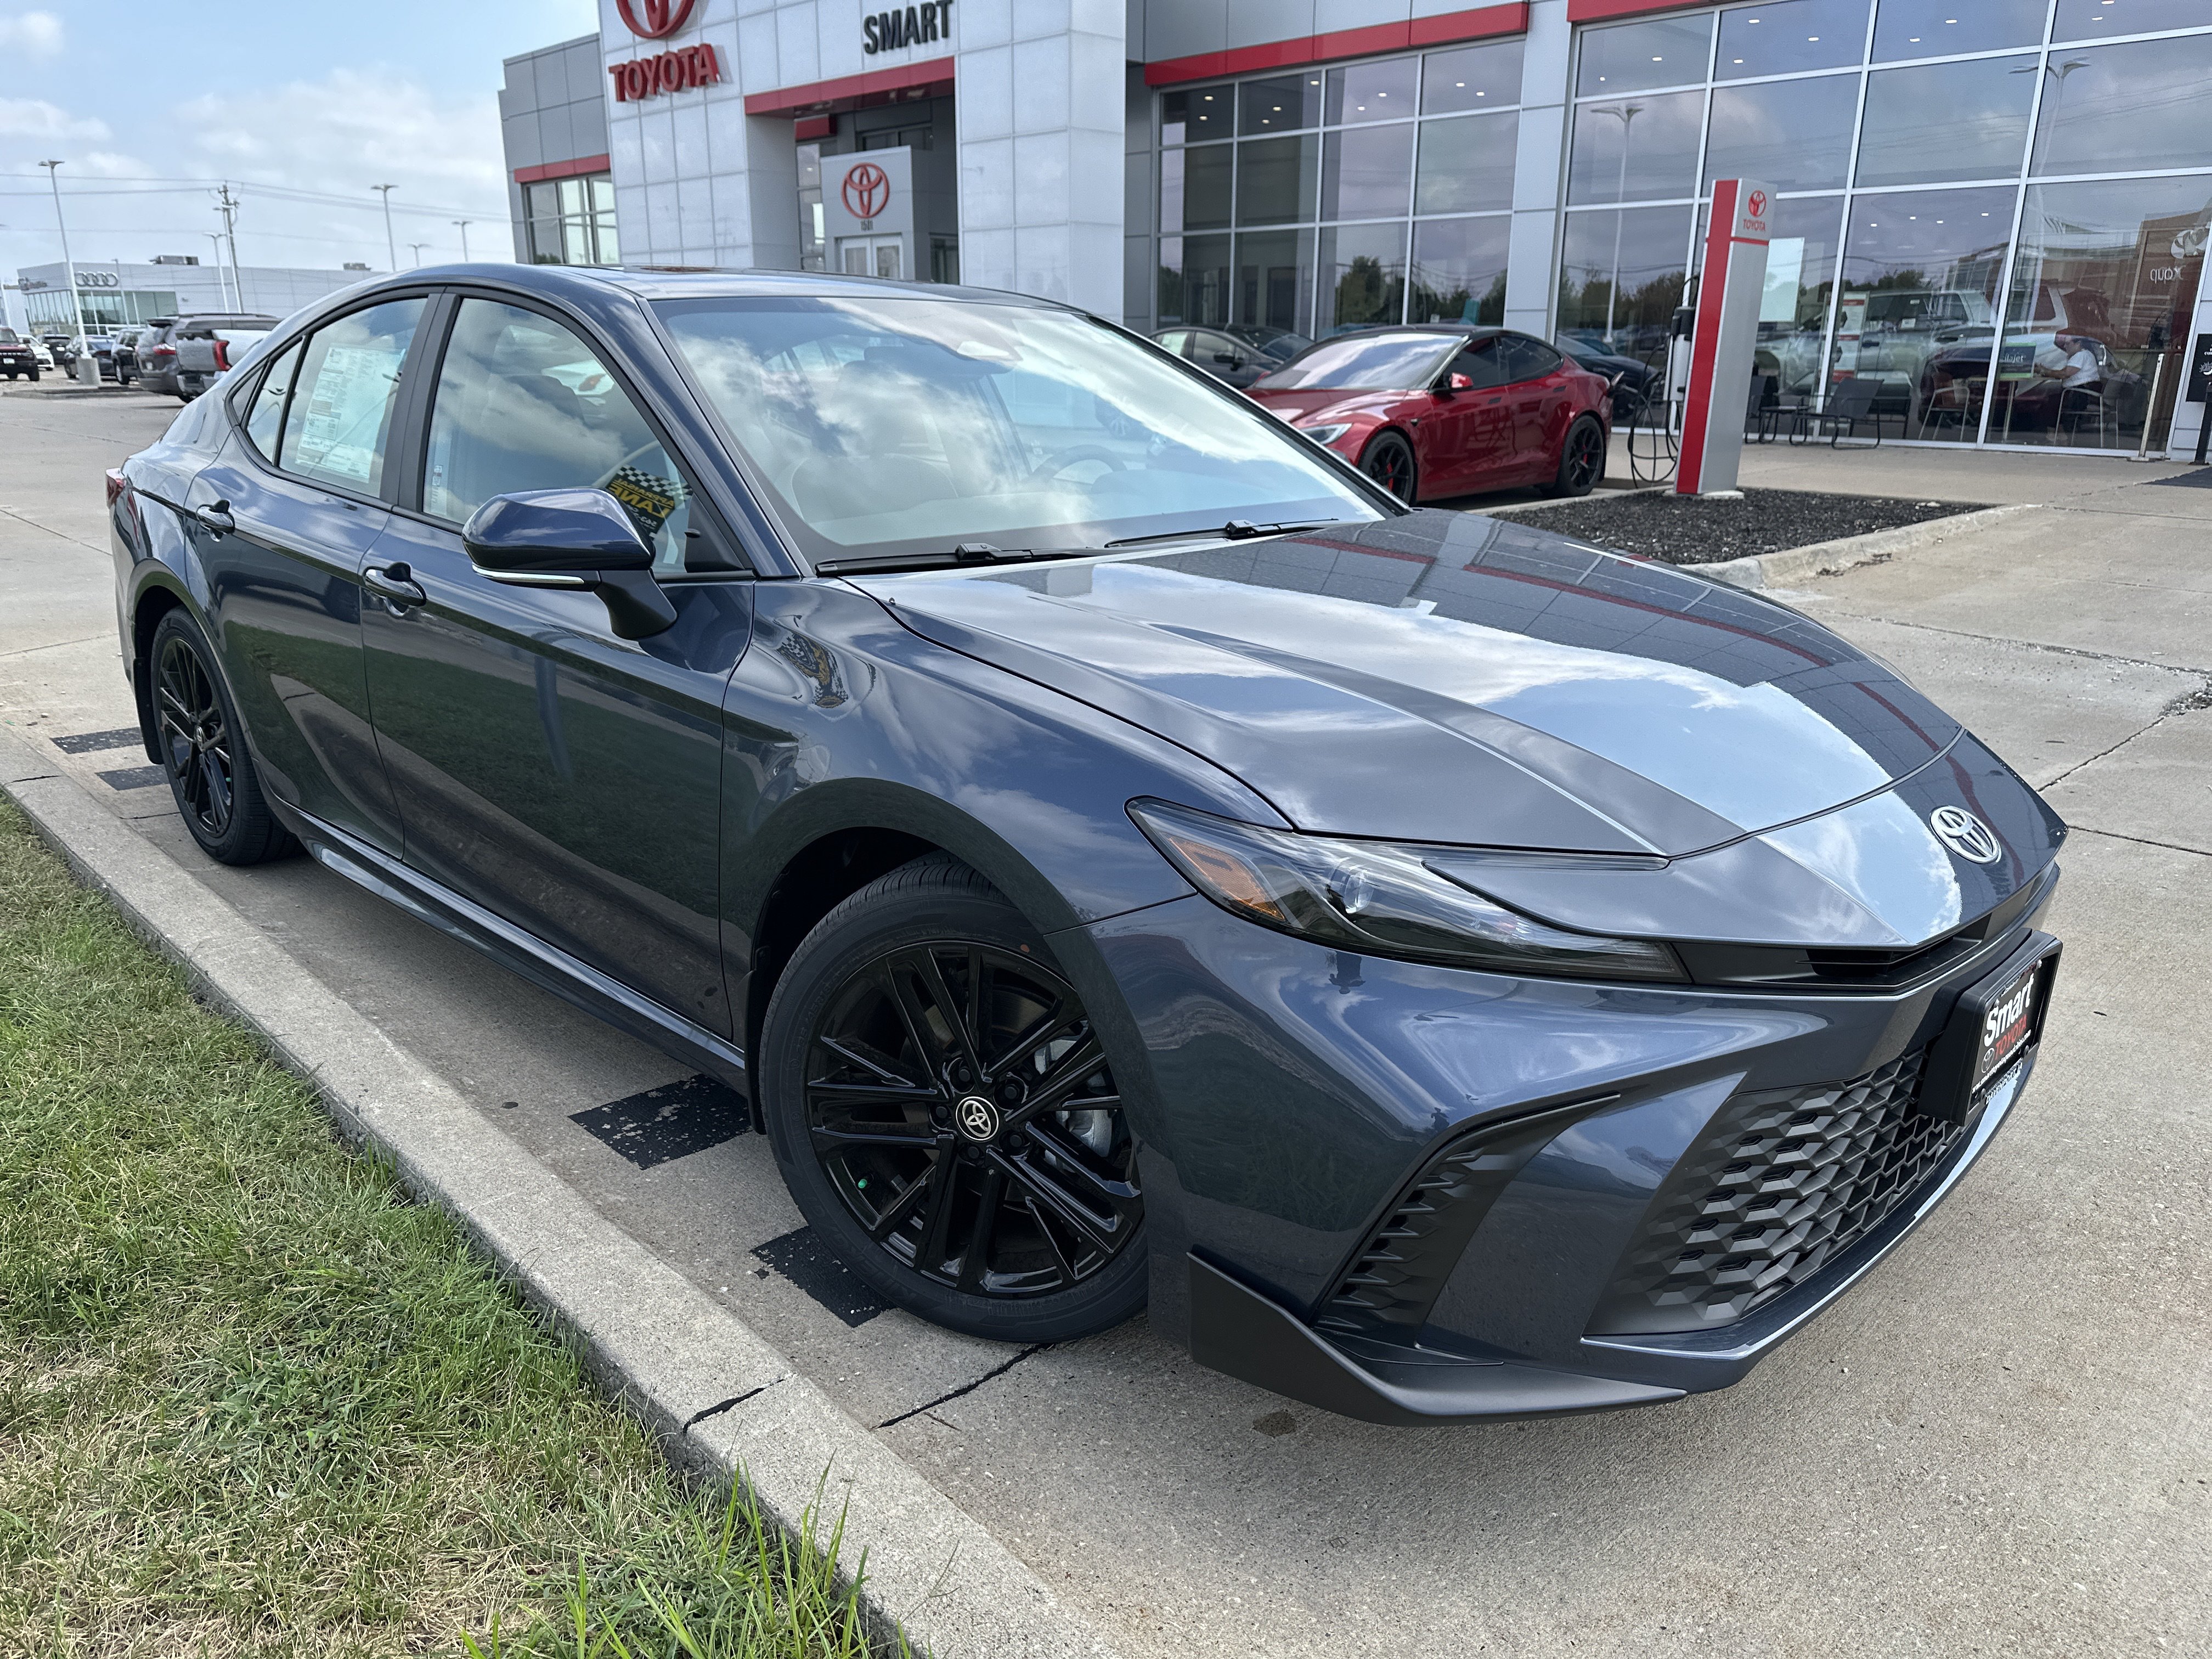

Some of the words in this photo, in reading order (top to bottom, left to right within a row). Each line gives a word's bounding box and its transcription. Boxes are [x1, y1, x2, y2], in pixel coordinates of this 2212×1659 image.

[864, 0, 953, 54] SMART
[608, 43, 720, 101] TOYOTA
[1743, 218, 1766, 232] TOYOTA
[1984, 972, 2034, 1047] Smart
[1995, 1014, 2028, 1061] TOYOTA
